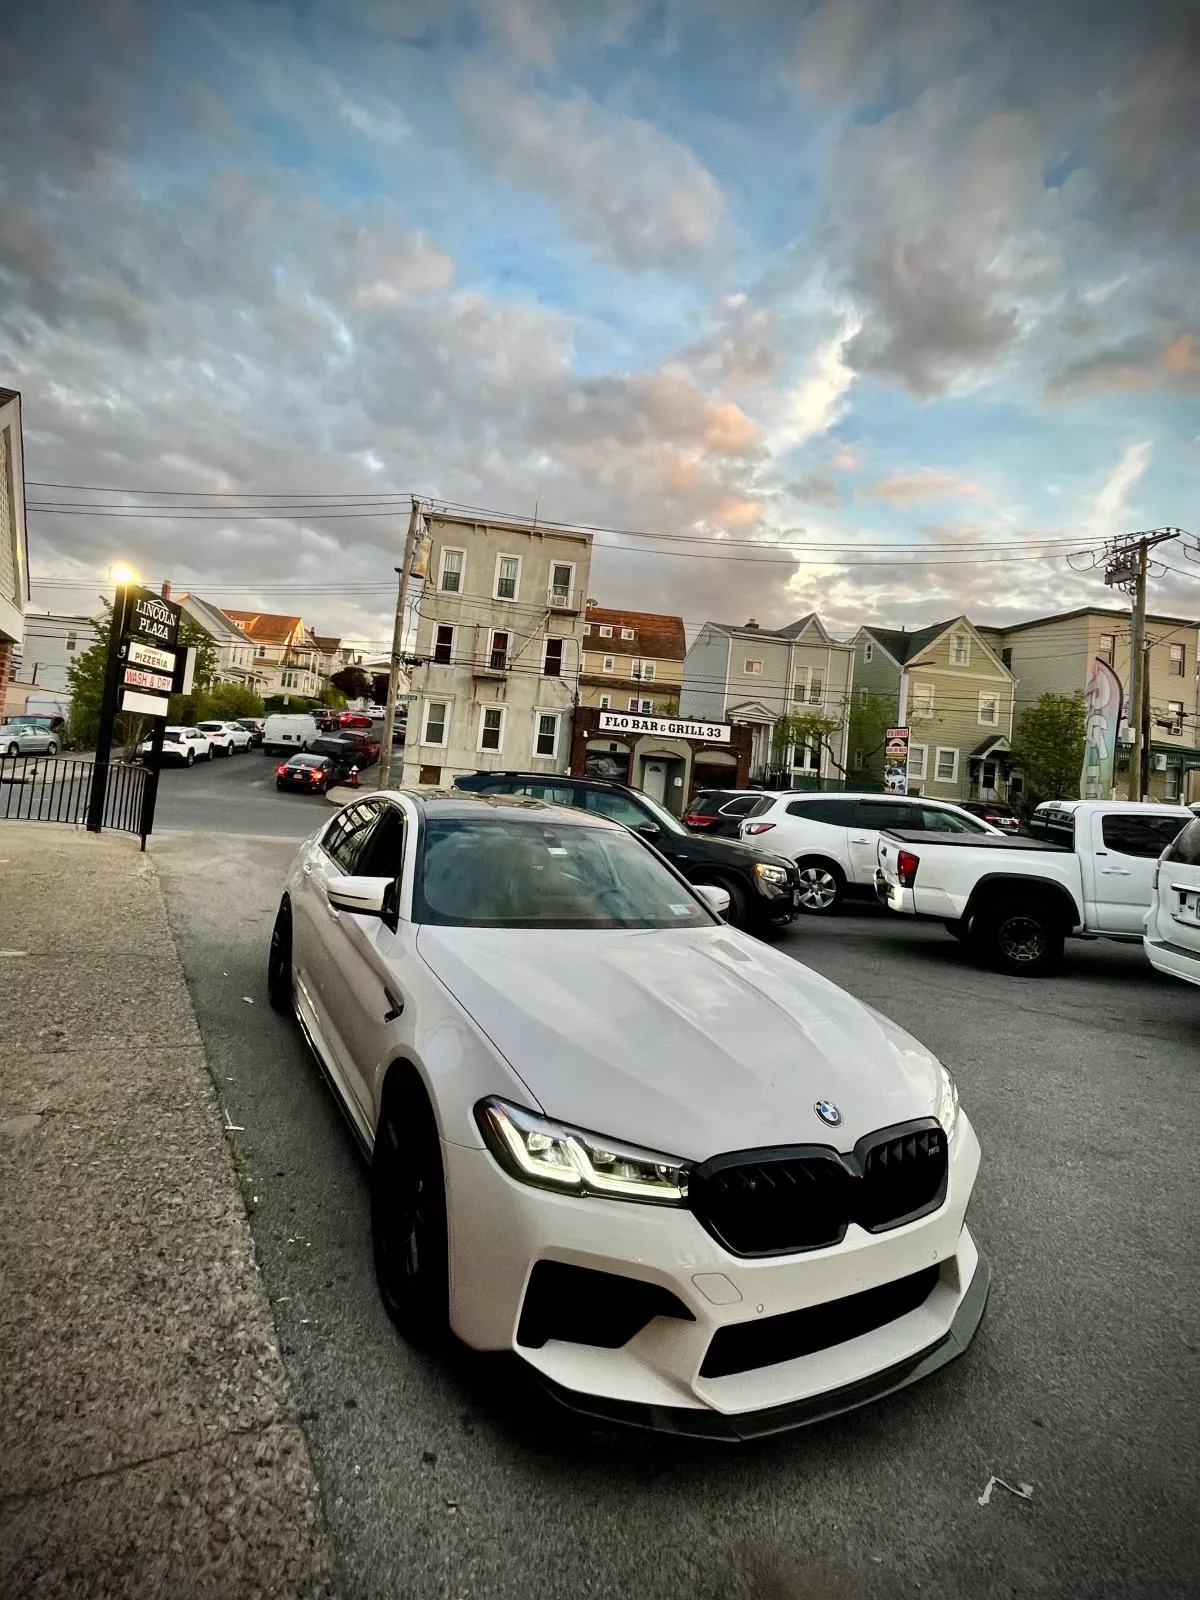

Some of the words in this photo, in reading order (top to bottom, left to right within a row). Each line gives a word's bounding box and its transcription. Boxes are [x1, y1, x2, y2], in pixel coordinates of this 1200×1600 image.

[136, 599, 177, 626] LINCOLN
[138, 617, 169, 640] PLAZA
[134, 652, 168, 669] PIZZERIA
[126, 670, 147, 685] WASH
[149, 677, 154, 687] &
[157, 677, 171, 689] DRY
[605, 716, 629, 728] FLO
[632, 719, 659, 732] BAR
[668, 723, 705, 737] GRILL
[706, 727, 722, 738] 33
